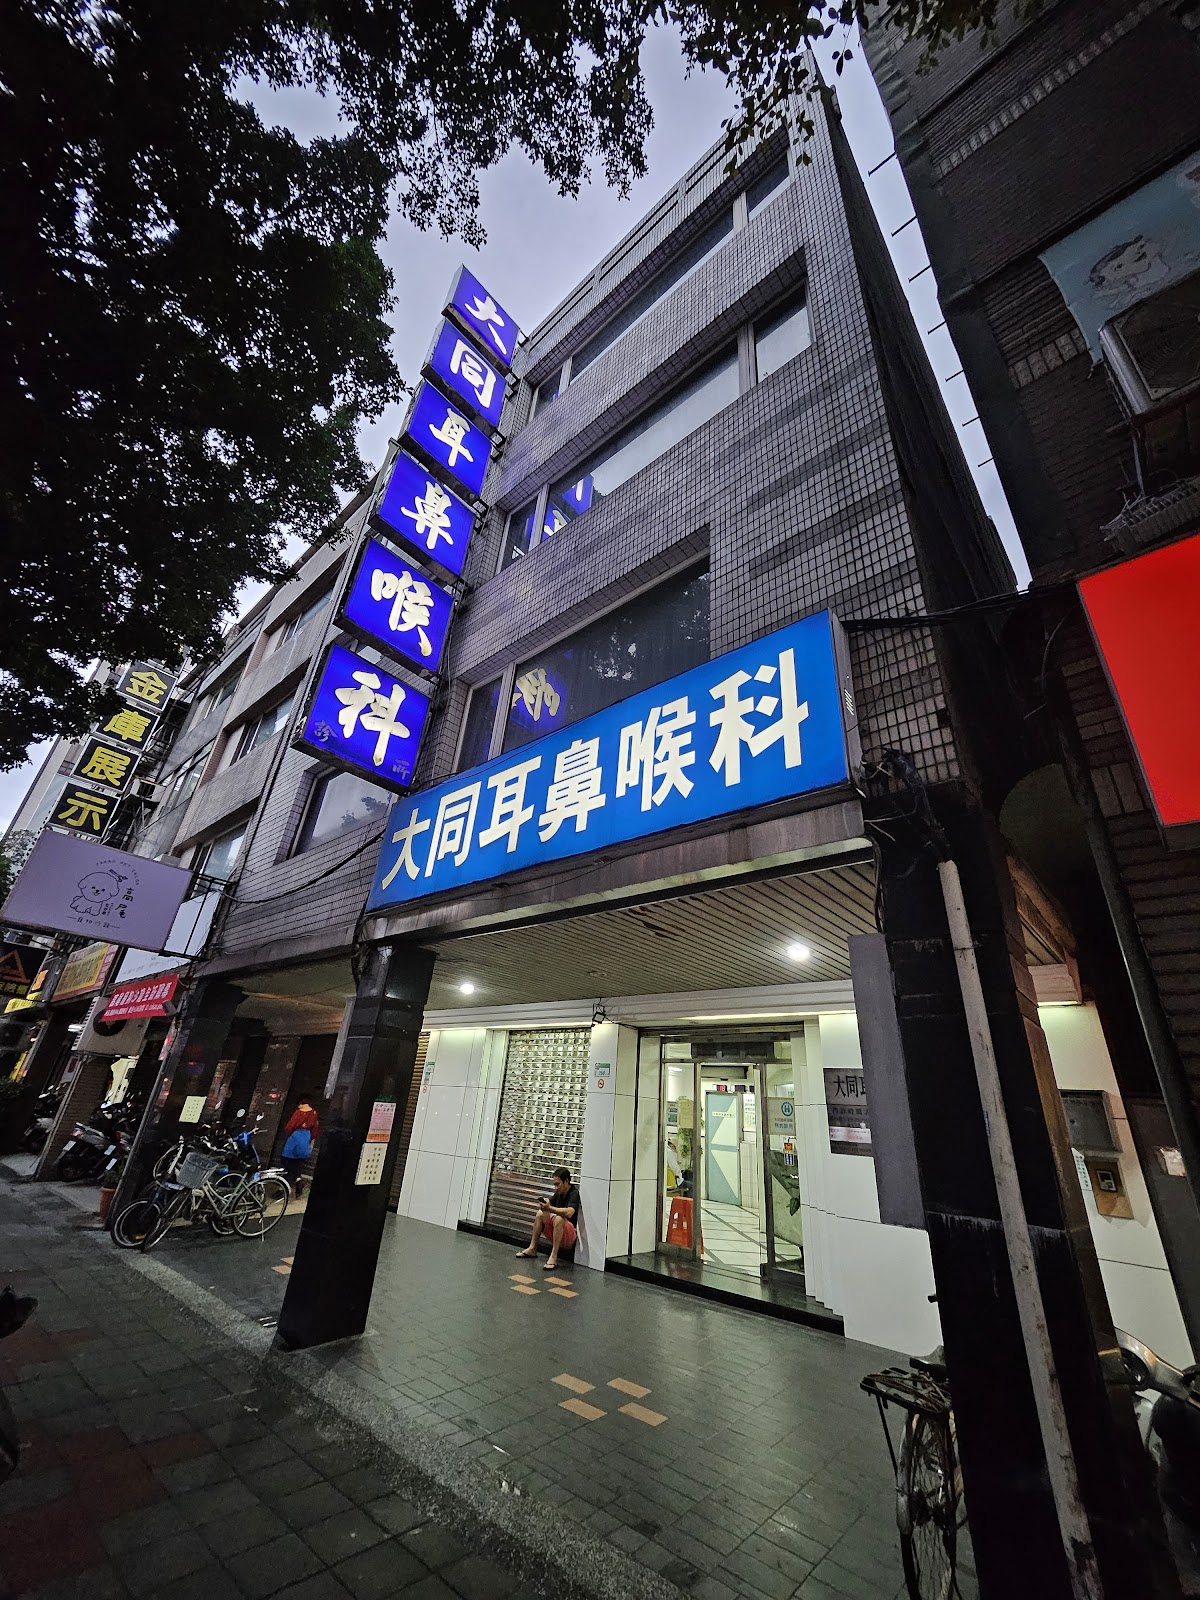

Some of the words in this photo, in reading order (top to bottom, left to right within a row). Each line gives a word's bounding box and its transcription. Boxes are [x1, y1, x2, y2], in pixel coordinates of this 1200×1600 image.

[335, 295, 507, 766] 大同耳鼻喉科
[58, 671, 168, 830] 金庫展示
[381, 648, 810, 890] 大同耳鼻喉科
